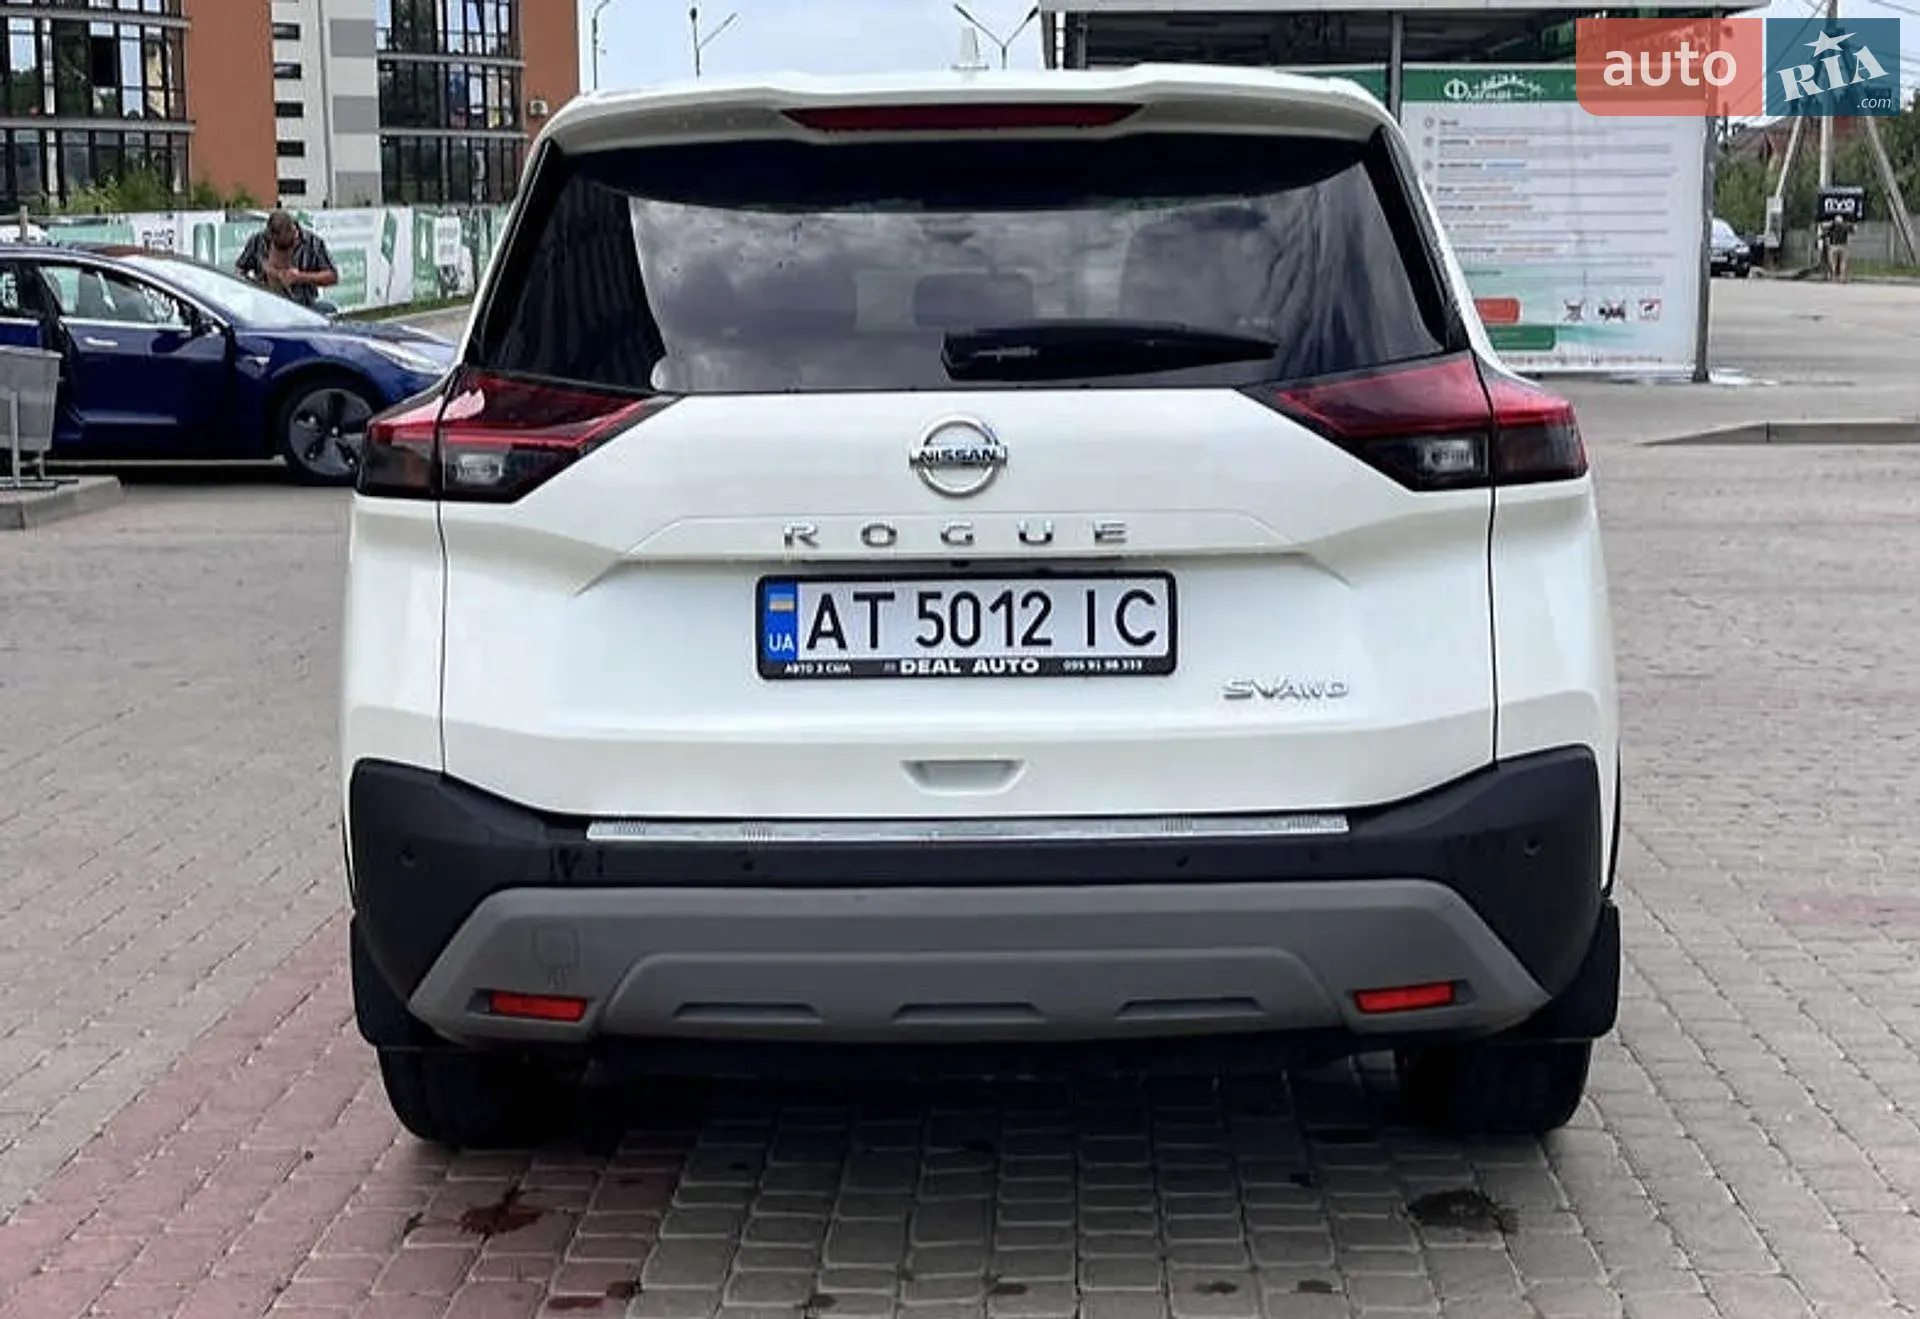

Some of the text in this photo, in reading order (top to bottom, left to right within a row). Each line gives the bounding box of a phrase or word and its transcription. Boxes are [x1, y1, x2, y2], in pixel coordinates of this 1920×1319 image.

[918, 448, 997, 463] NISSAN
[784, 522, 1127, 547] ROGUE
[806, 588, 1157, 650] AT 5012 IC
[768, 631, 796, 653] UA
[901, 659, 961, 674] DEAL
[973, 658, 1040, 673] AUTO
